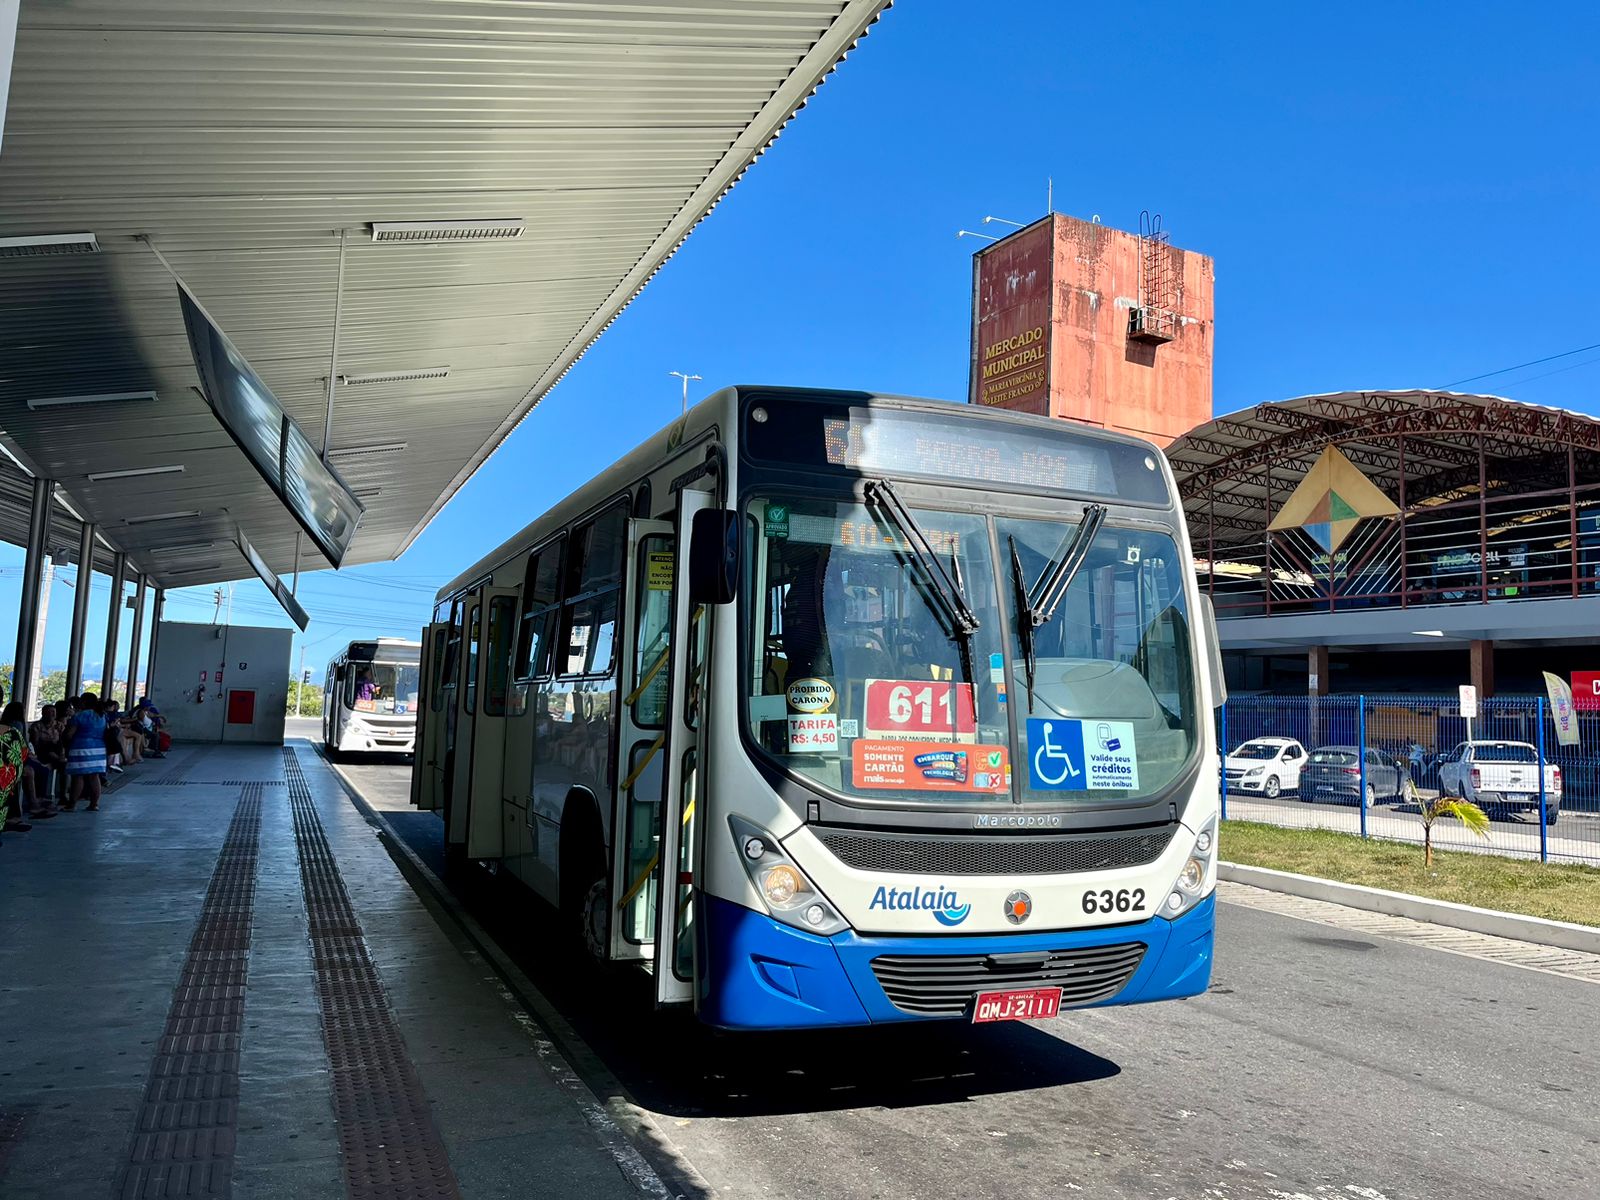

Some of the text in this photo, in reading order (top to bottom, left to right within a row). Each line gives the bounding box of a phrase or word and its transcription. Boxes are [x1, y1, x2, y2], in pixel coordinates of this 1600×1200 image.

[985, 327, 1043, 360] MERCADO
[983, 345, 1045, 379] MUNICIPAL
[990, 384, 1034, 404] LEITE FRANCO
[841, 521, 877, 546] 611
[790, 685, 831, 693] PROIBIDO
[792, 696, 830, 704] CARONA
[888, 685, 955, 725] 611
[790, 719, 835, 730] TARIFA
[812, 733, 836, 745] 4,50
[864, 753, 904, 762] SOMENTE
[917, 753, 954, 763] EMBARQUE
[1091, 754, 1113, 762] Valide
[864, 761, 905, 773] CARTÃO
[1092, 763, 1132, 774] créditos
[863, 774, 885, 783] mais
[1112, 780, 1133, 788] ônibus
[977, 814, 1060, 829] Marcopolo
[868, 885, 964, 912] Atalaia
[1081, 888, 1146, 915] 6362
